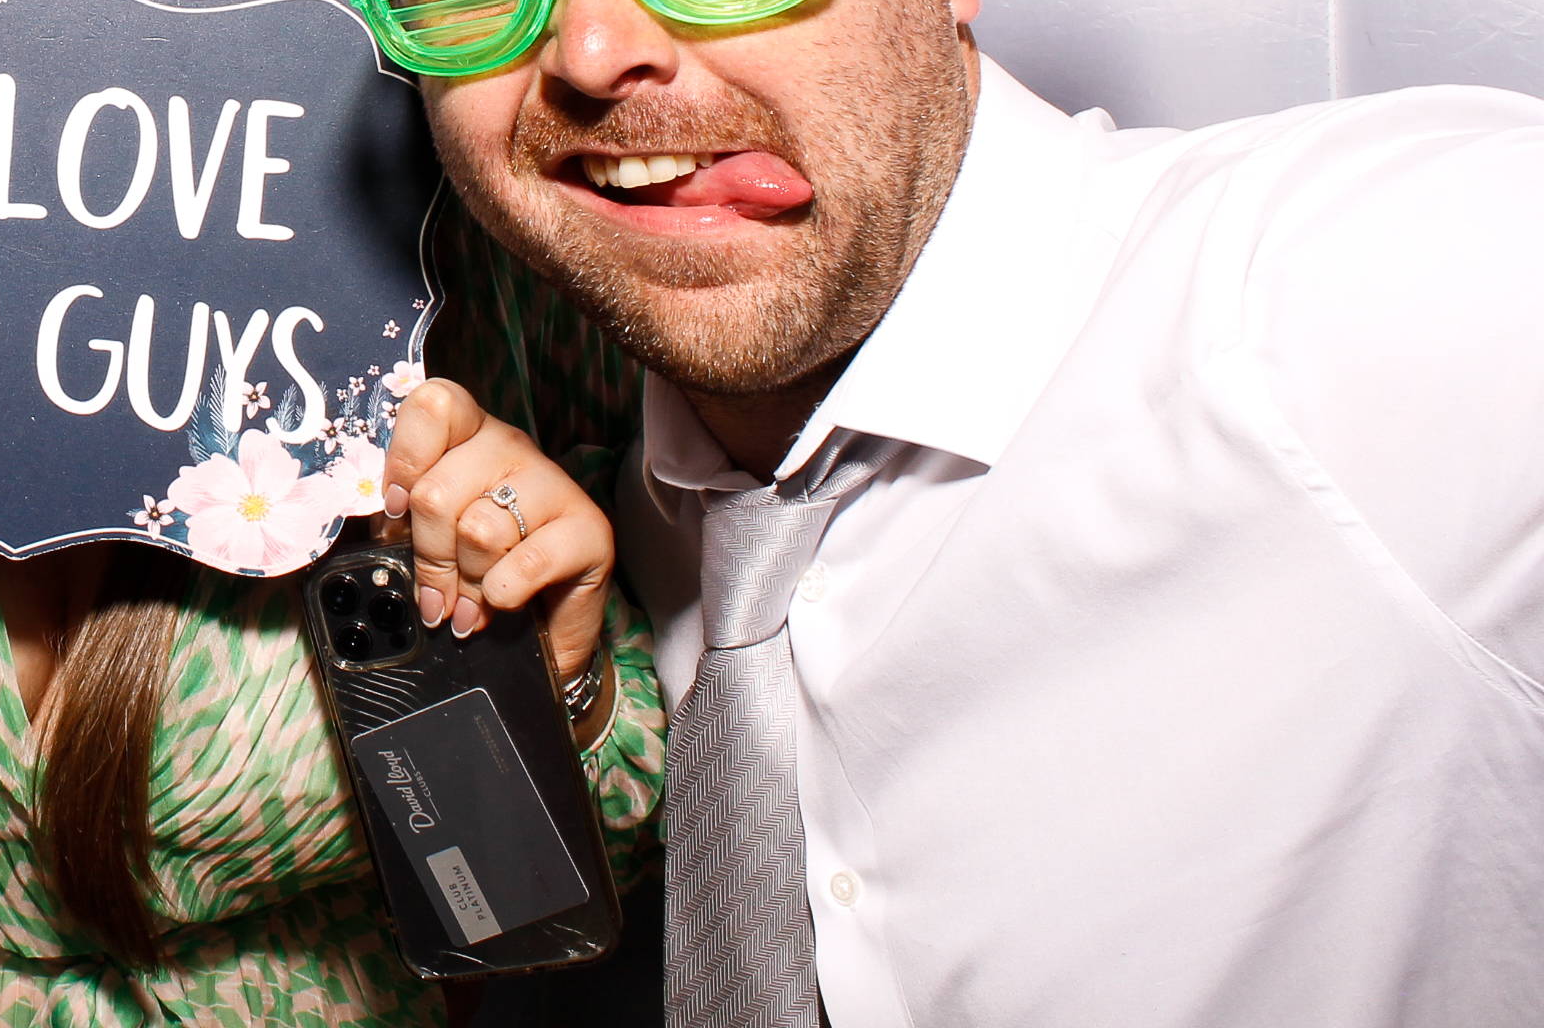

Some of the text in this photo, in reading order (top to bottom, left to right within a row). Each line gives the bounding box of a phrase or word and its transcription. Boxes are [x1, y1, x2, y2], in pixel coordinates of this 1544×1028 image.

[36, 284, 325, 445] GUYS
[377, 749, 436, 834] David Lloyd
[413, 770, 432, 799] CLUBS
[448, 882, 468, 911] CLUB
[452, 864, 486, 922] PLATINUM
